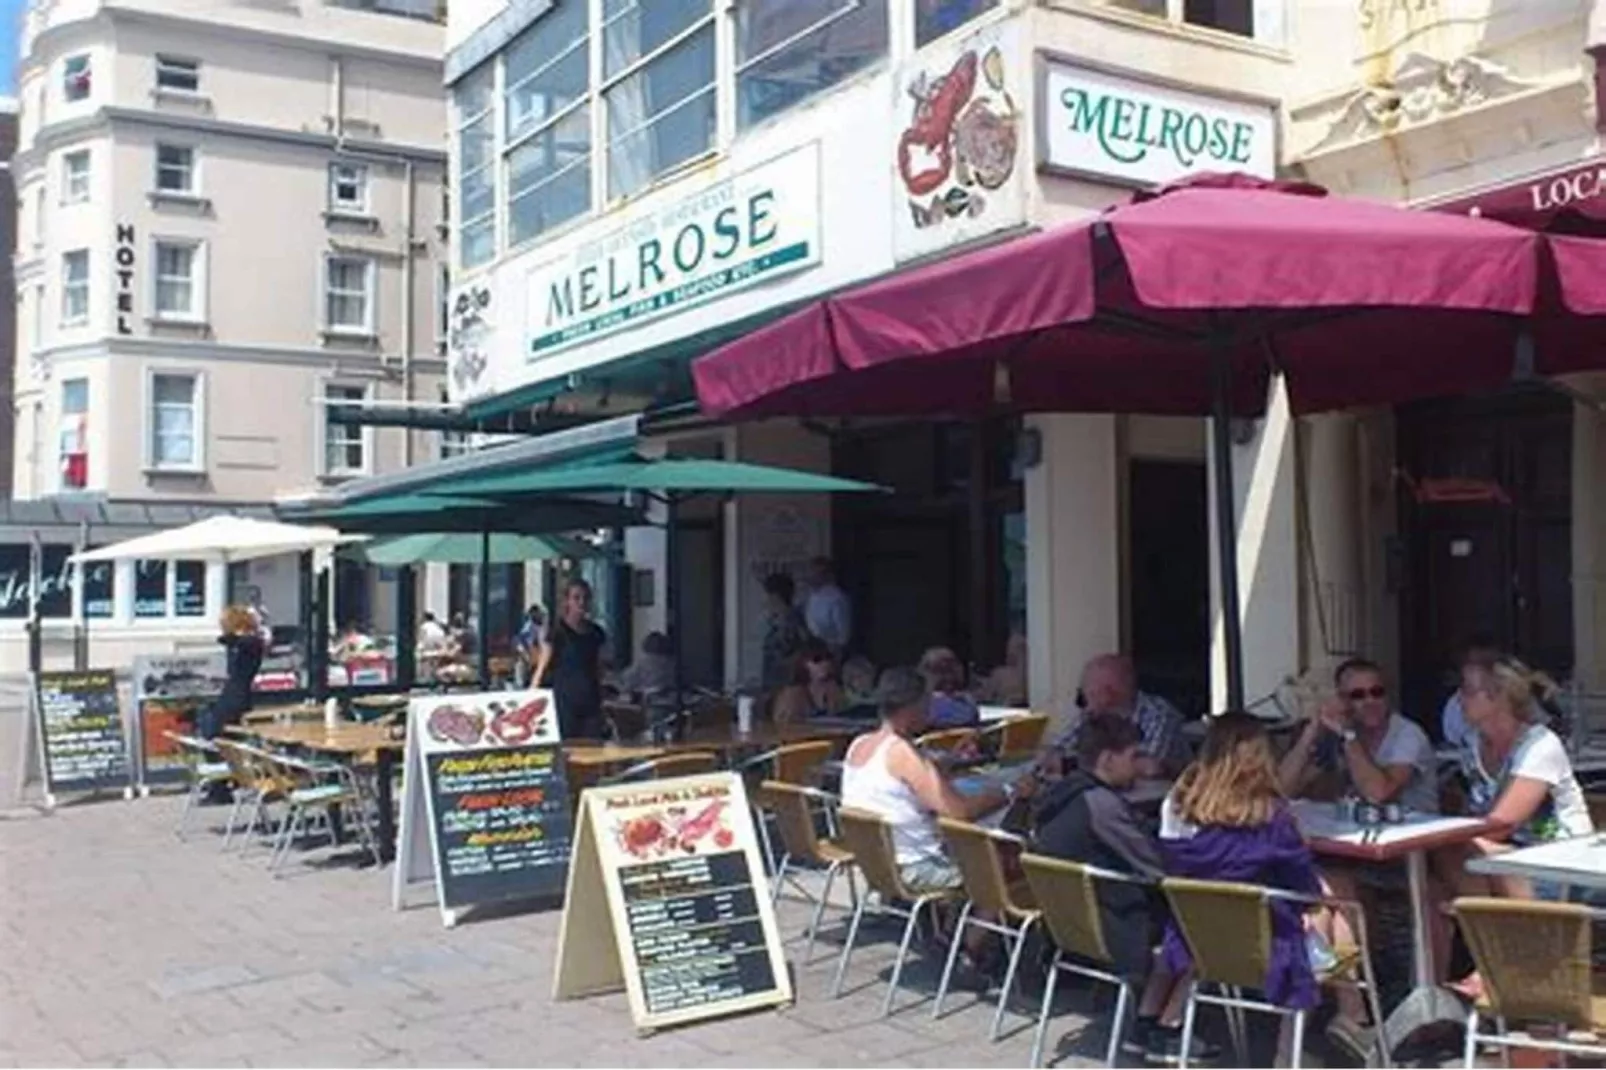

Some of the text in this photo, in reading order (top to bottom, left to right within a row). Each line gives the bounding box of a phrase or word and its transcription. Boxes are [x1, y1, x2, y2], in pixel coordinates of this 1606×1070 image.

[1060, 87, 1254, 168] MELROSE
[116, 223, 134, 335] HOTEL
[545, 189, 778, 327] MELROSE
